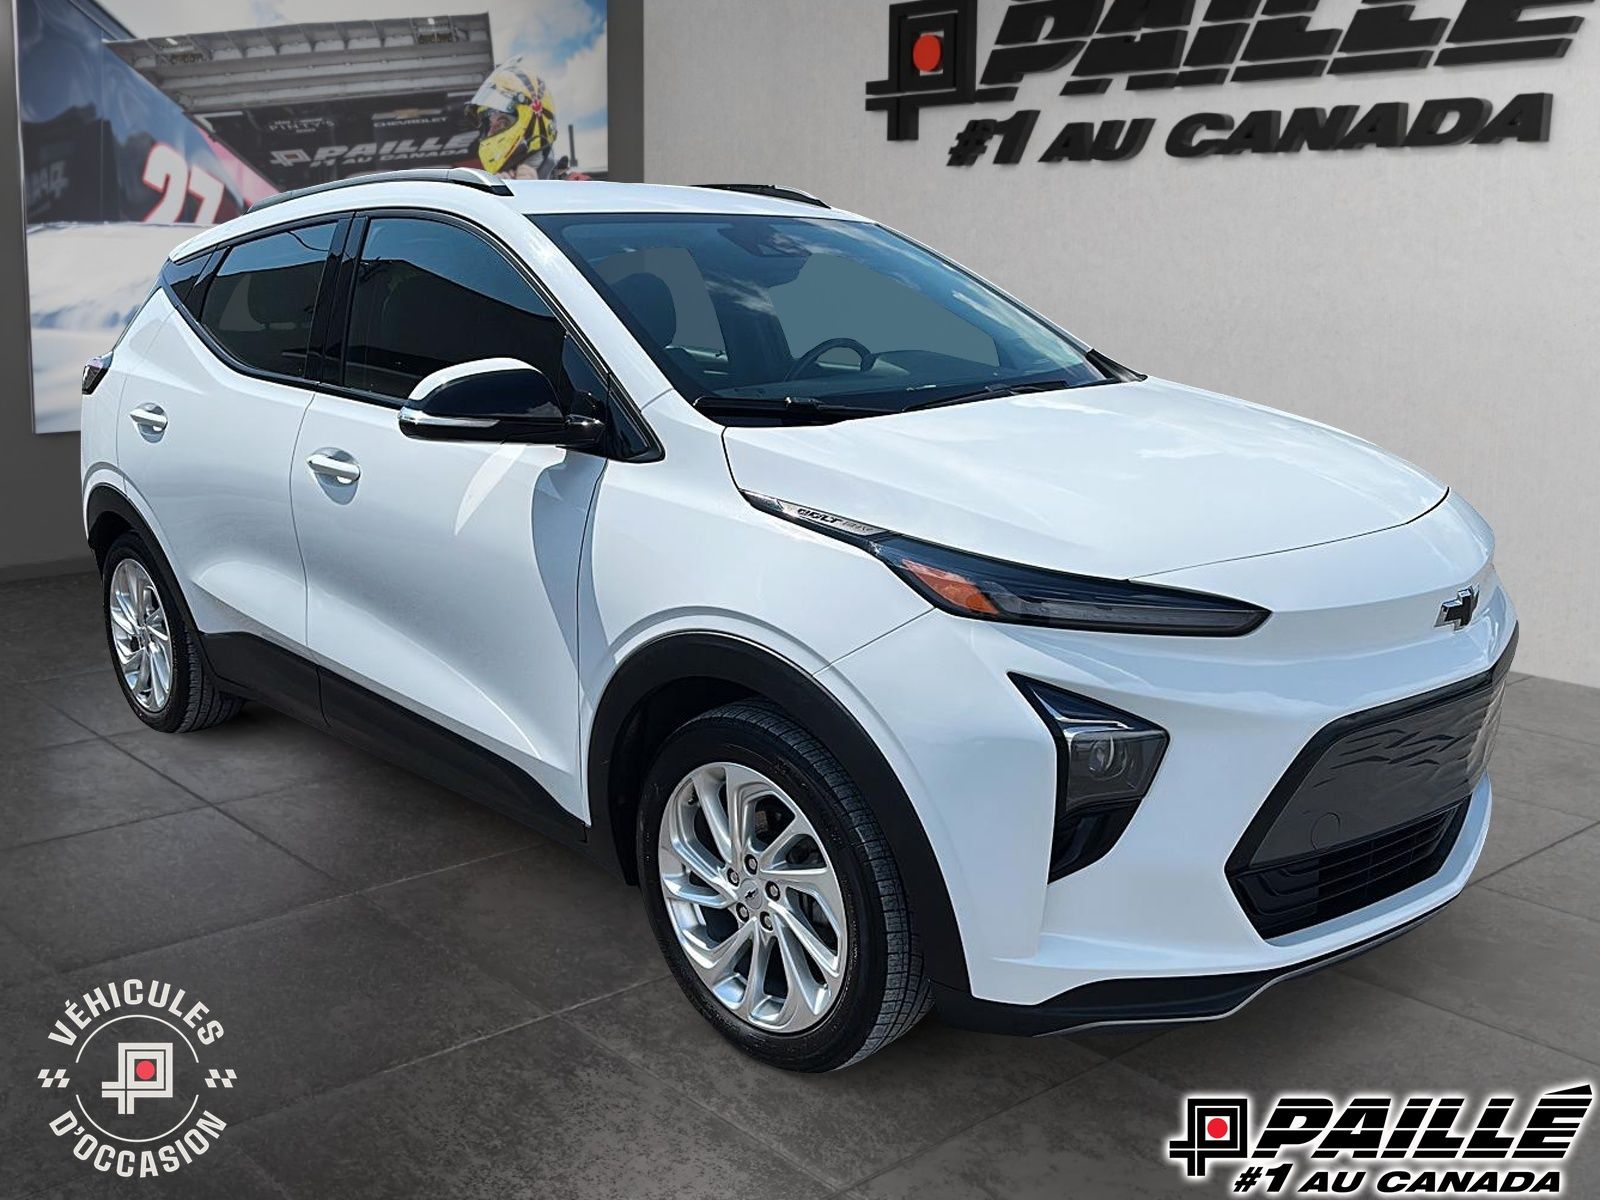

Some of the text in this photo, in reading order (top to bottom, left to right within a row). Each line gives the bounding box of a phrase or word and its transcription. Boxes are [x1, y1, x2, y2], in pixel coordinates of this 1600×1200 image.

[374, 116, 448, 127] CHEVROLET
[947, 93, 1555, 167] #1 AU CANADA
[341, 156, 374, 165] AU
[379, 148, 469, 161] CANADA
[143, 142, 225, 223] 27
